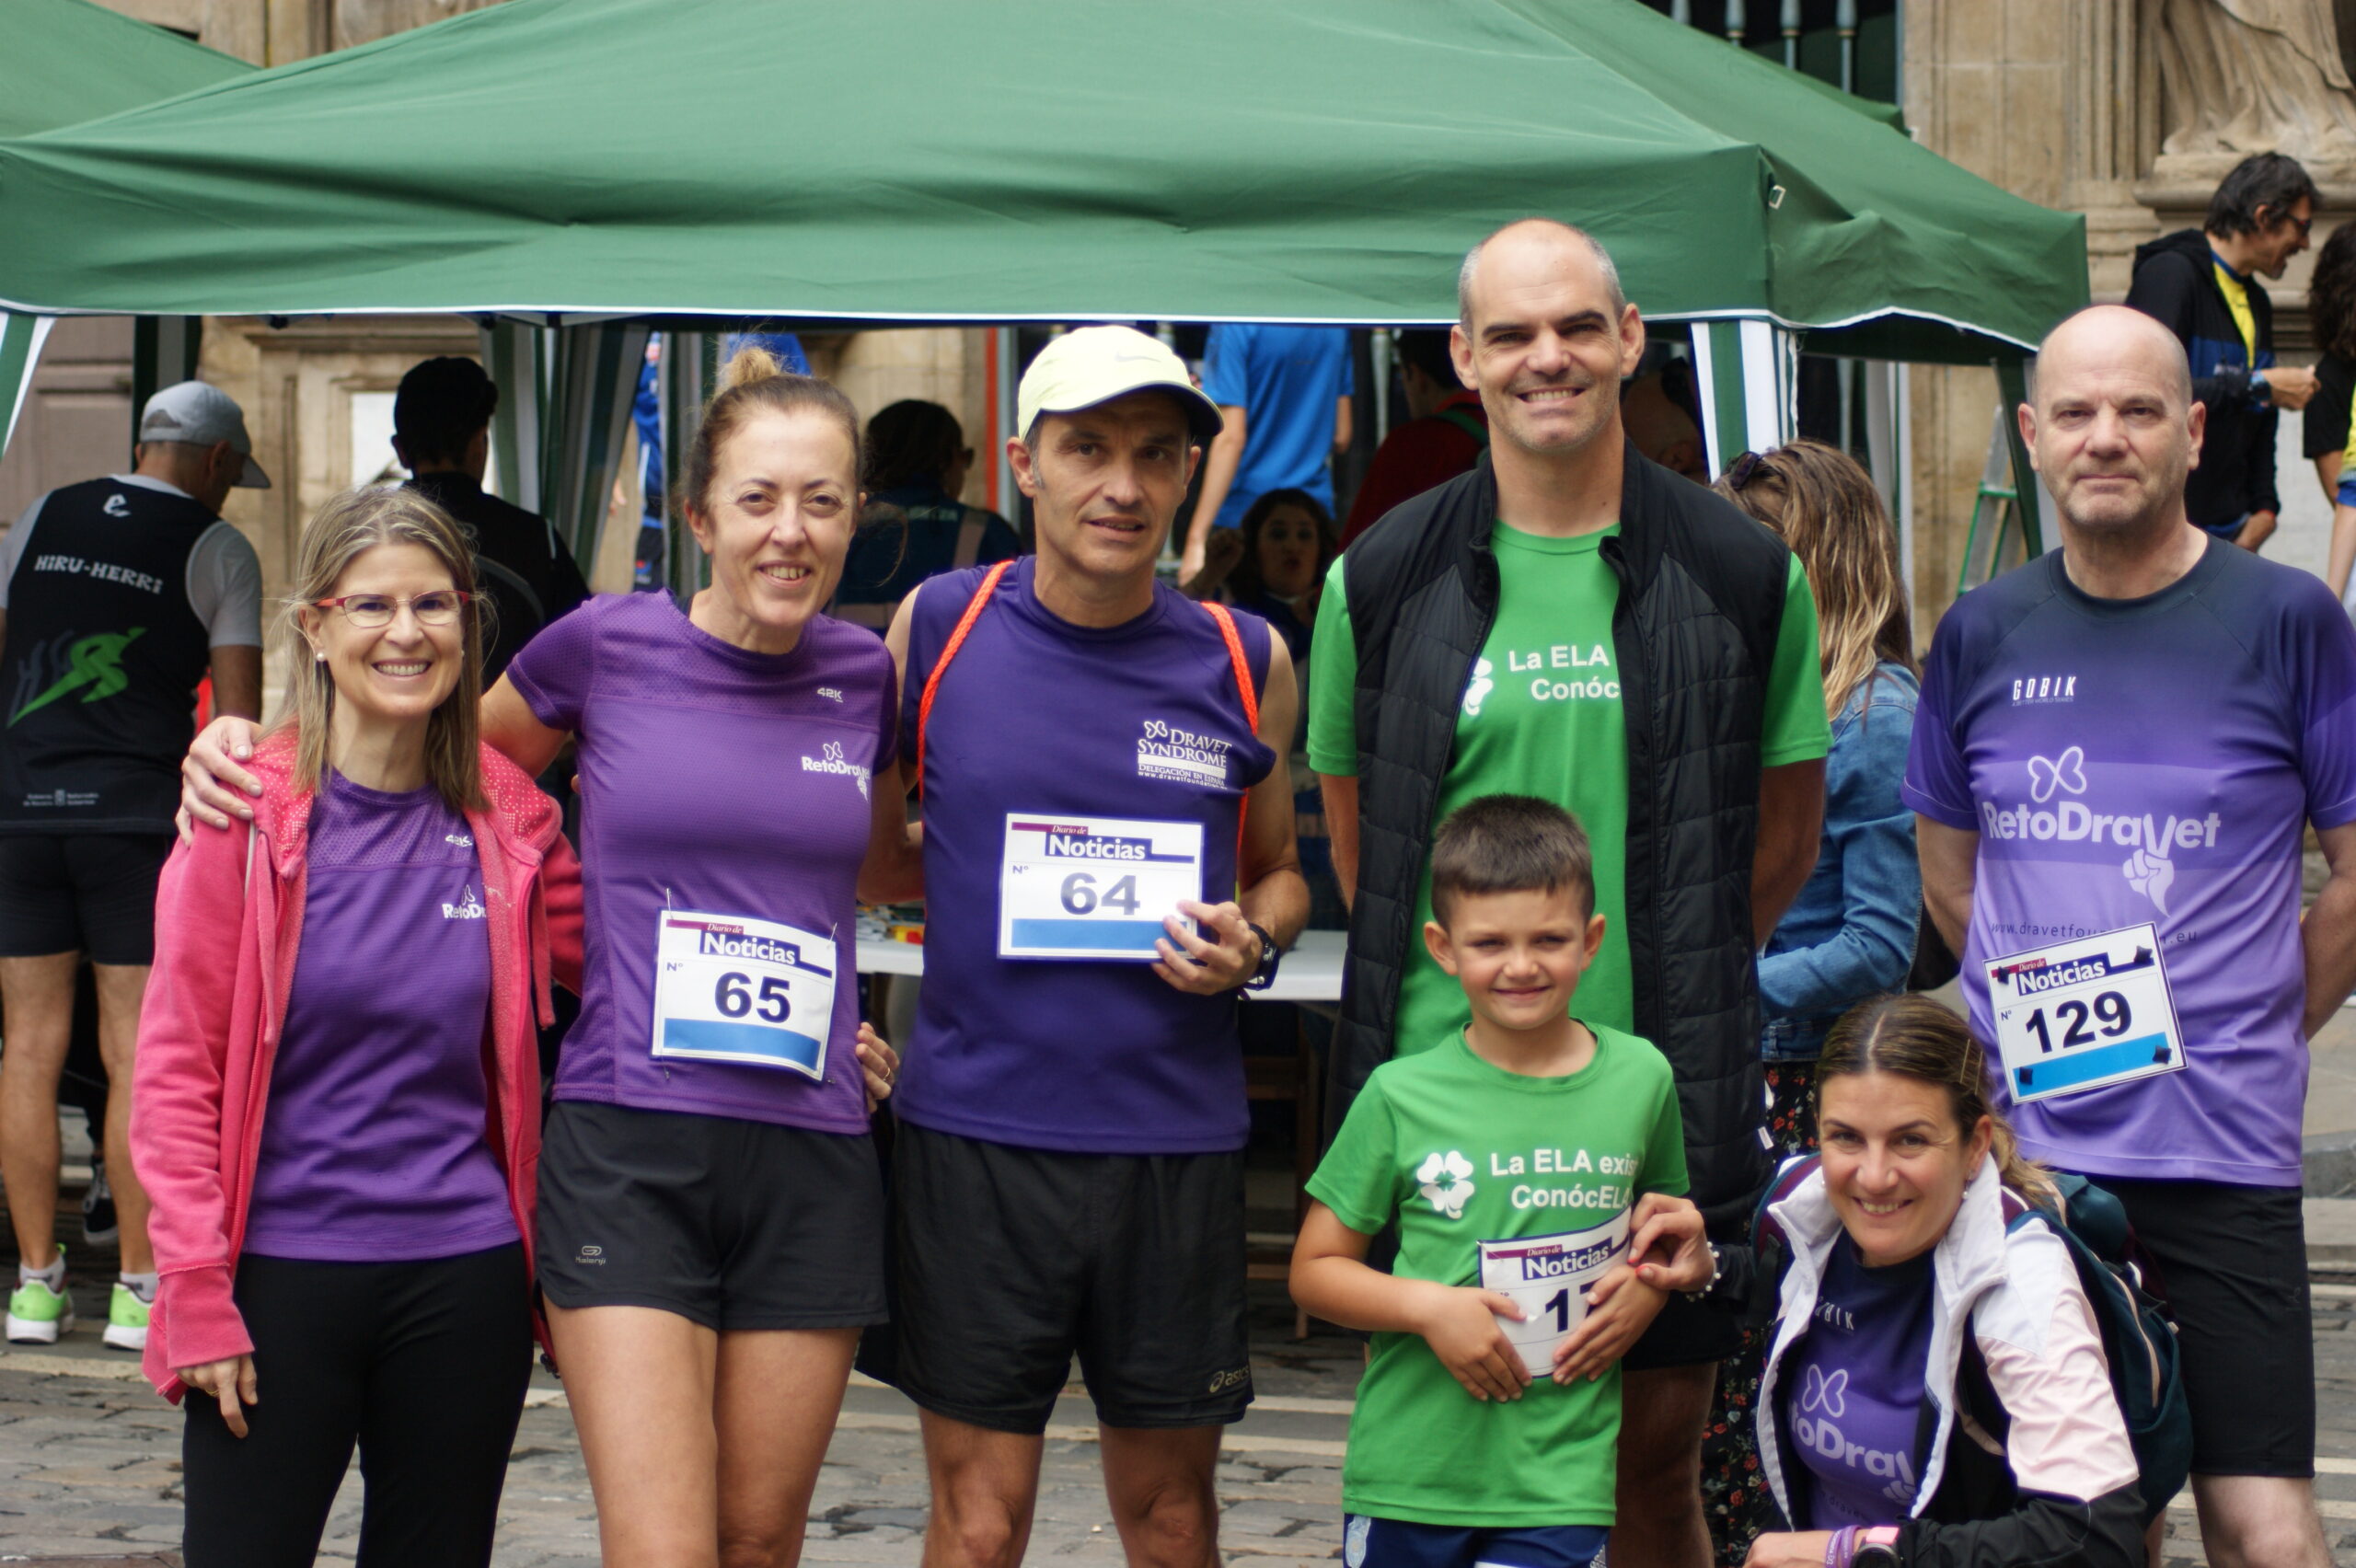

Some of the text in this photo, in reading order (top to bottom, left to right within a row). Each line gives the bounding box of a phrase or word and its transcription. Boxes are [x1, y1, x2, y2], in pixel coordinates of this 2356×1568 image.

[1509, 645, 1610, 672] La ELA
[817, 687, 843, 702] 42K
[2013, 676, 2076, 700] GOBIK
[1138, 739, 1226, 767] SYNDROME
[1170, 729, 1232, 754] DRAVET
[1138, 764, 1191, 778] DELEGACIÓN
[1194, 772, 1202, 780] EN
[1052, 824, 1087, 835] Diario de
[1982, 801, 2221, 858] RetoDravet
[1048, 835, 1146, 859] Noticias
[1060, 872, 1140, 916] 64
[707, 923, 742, 933] Diario de
[703, 933, 795, 965] Noticias
[2018, 959, 2046, 972] Diario de
[2019, 960, 2105, 995] Noticias
[714, 971, 791, 1023] 65
[2026, 991, 2132, 1054] 129
[1491, 1152, 1524, 1176] La
[1534, 1149, 1592, 1173] ELA
[1526, 1246, 1609, 1279] Noticias
[1527, 1245, 1562, 1257] Diario de
